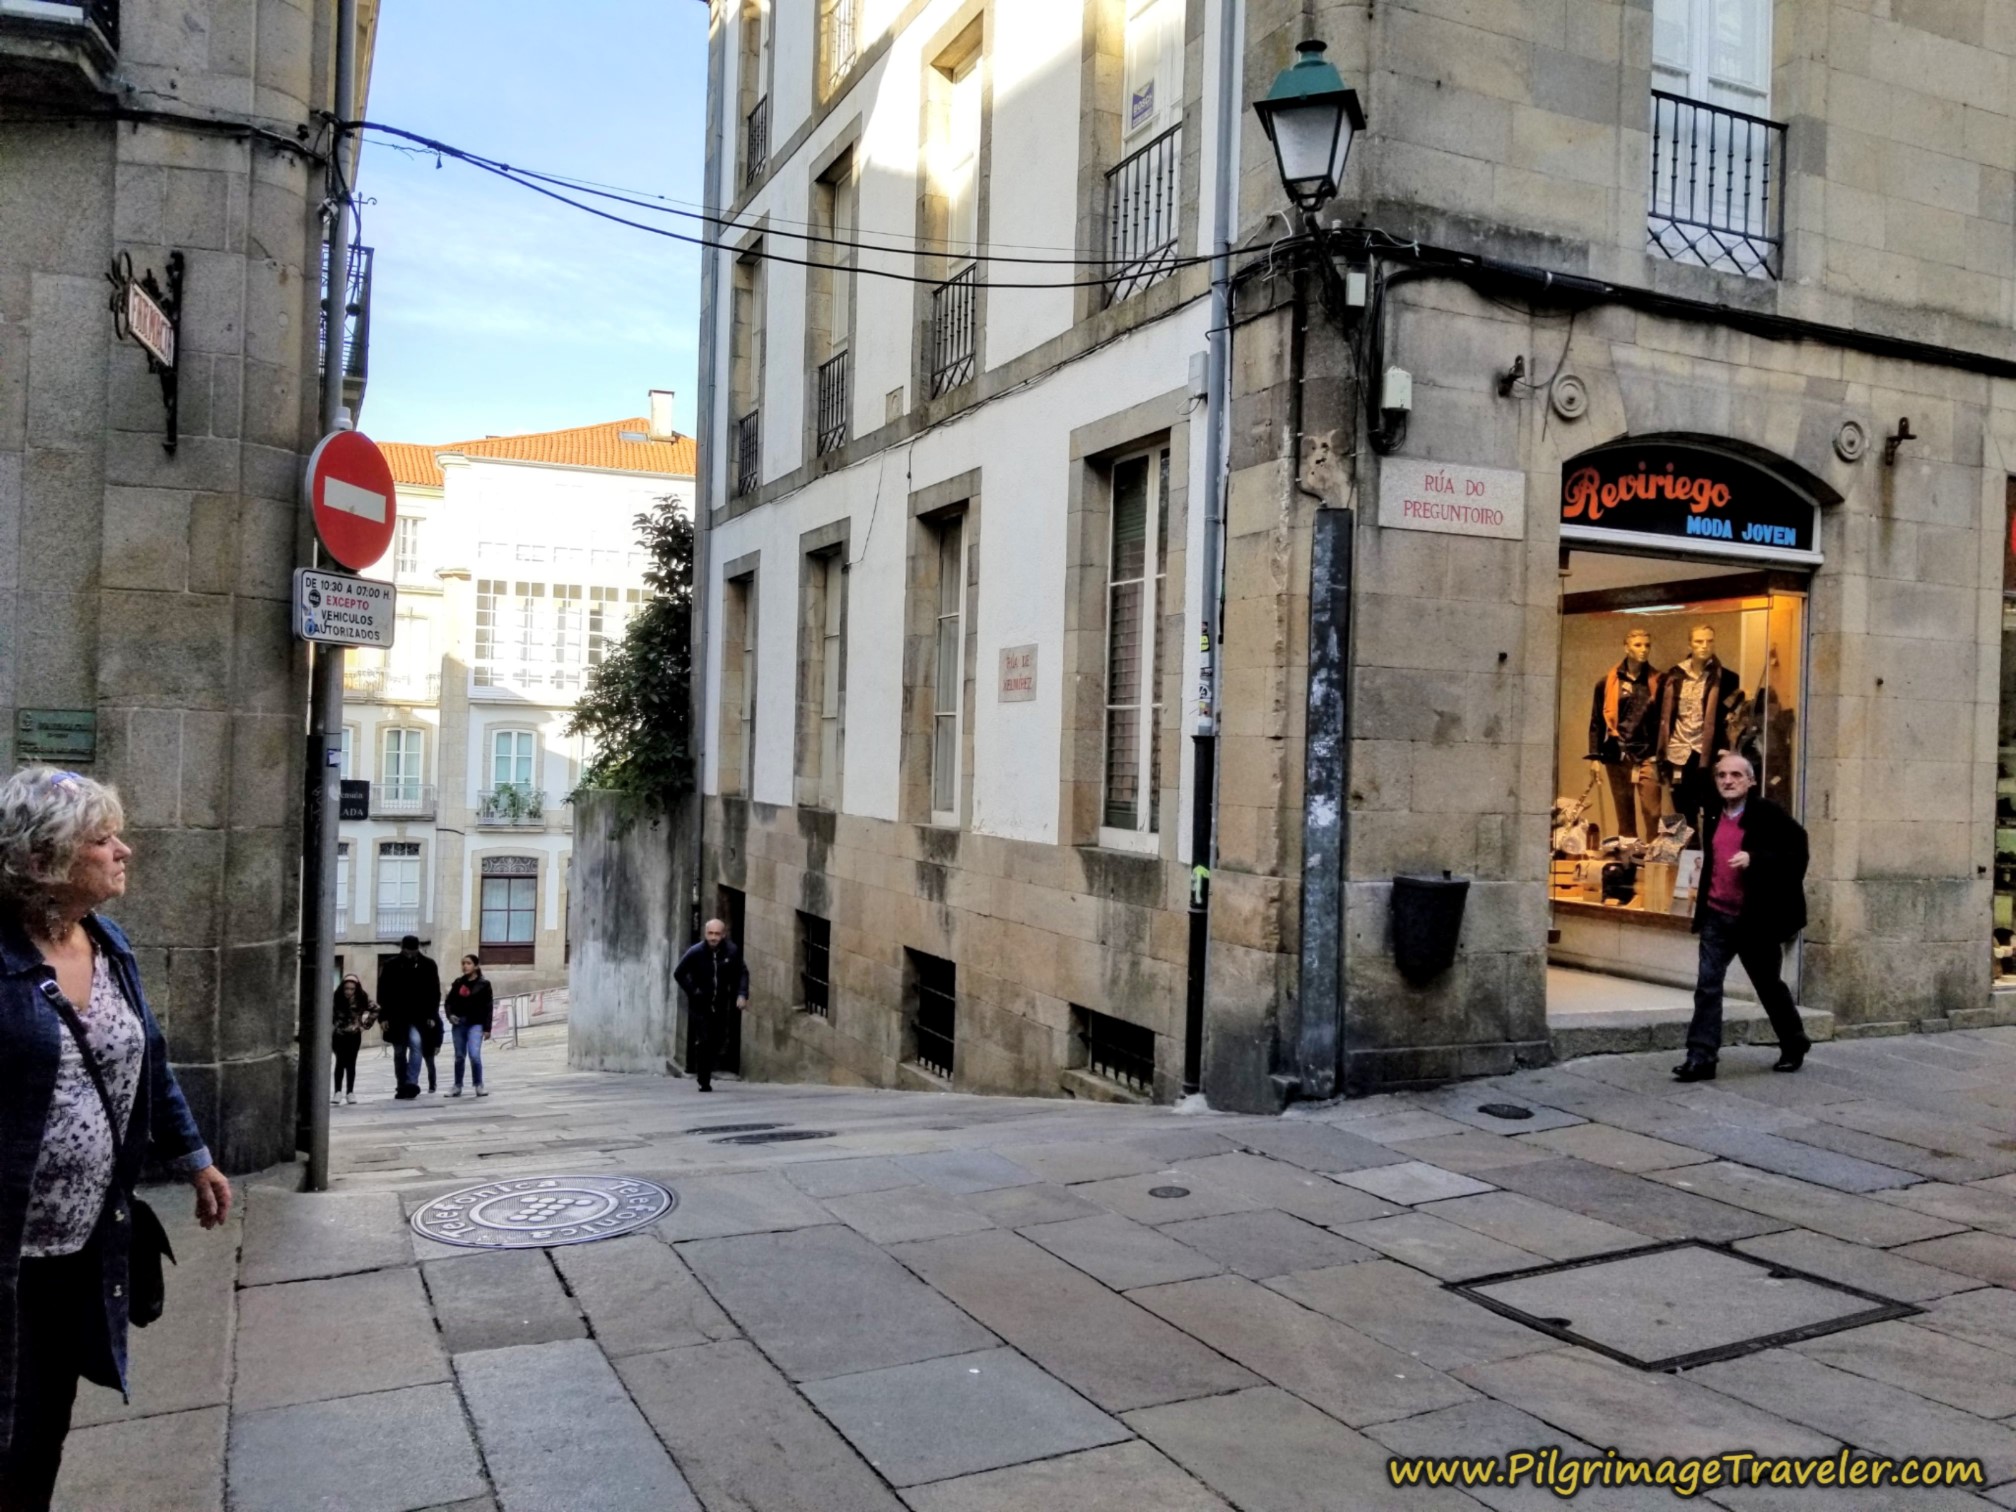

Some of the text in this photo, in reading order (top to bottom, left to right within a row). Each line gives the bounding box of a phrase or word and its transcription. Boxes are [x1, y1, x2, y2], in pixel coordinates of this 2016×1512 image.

[1424, 469, 1485, 497] RÚA DO
[1562, 461, 1732, 520] Reviriego
[1403, 500, 1504, 526] PREGUNTOIRO
[1687, 515, 1796, 546] MODA JOVEN
[305, 577, 317, 589] DE
[346, 584, 353, 595] A
[356, 586, 380, 599] 07:00
[326, 595, 370, 611] EXCEPTO
[321, 609, 374, 626] VEHICULOS
[314, 623, 380, 641] AUTORIZADOS
